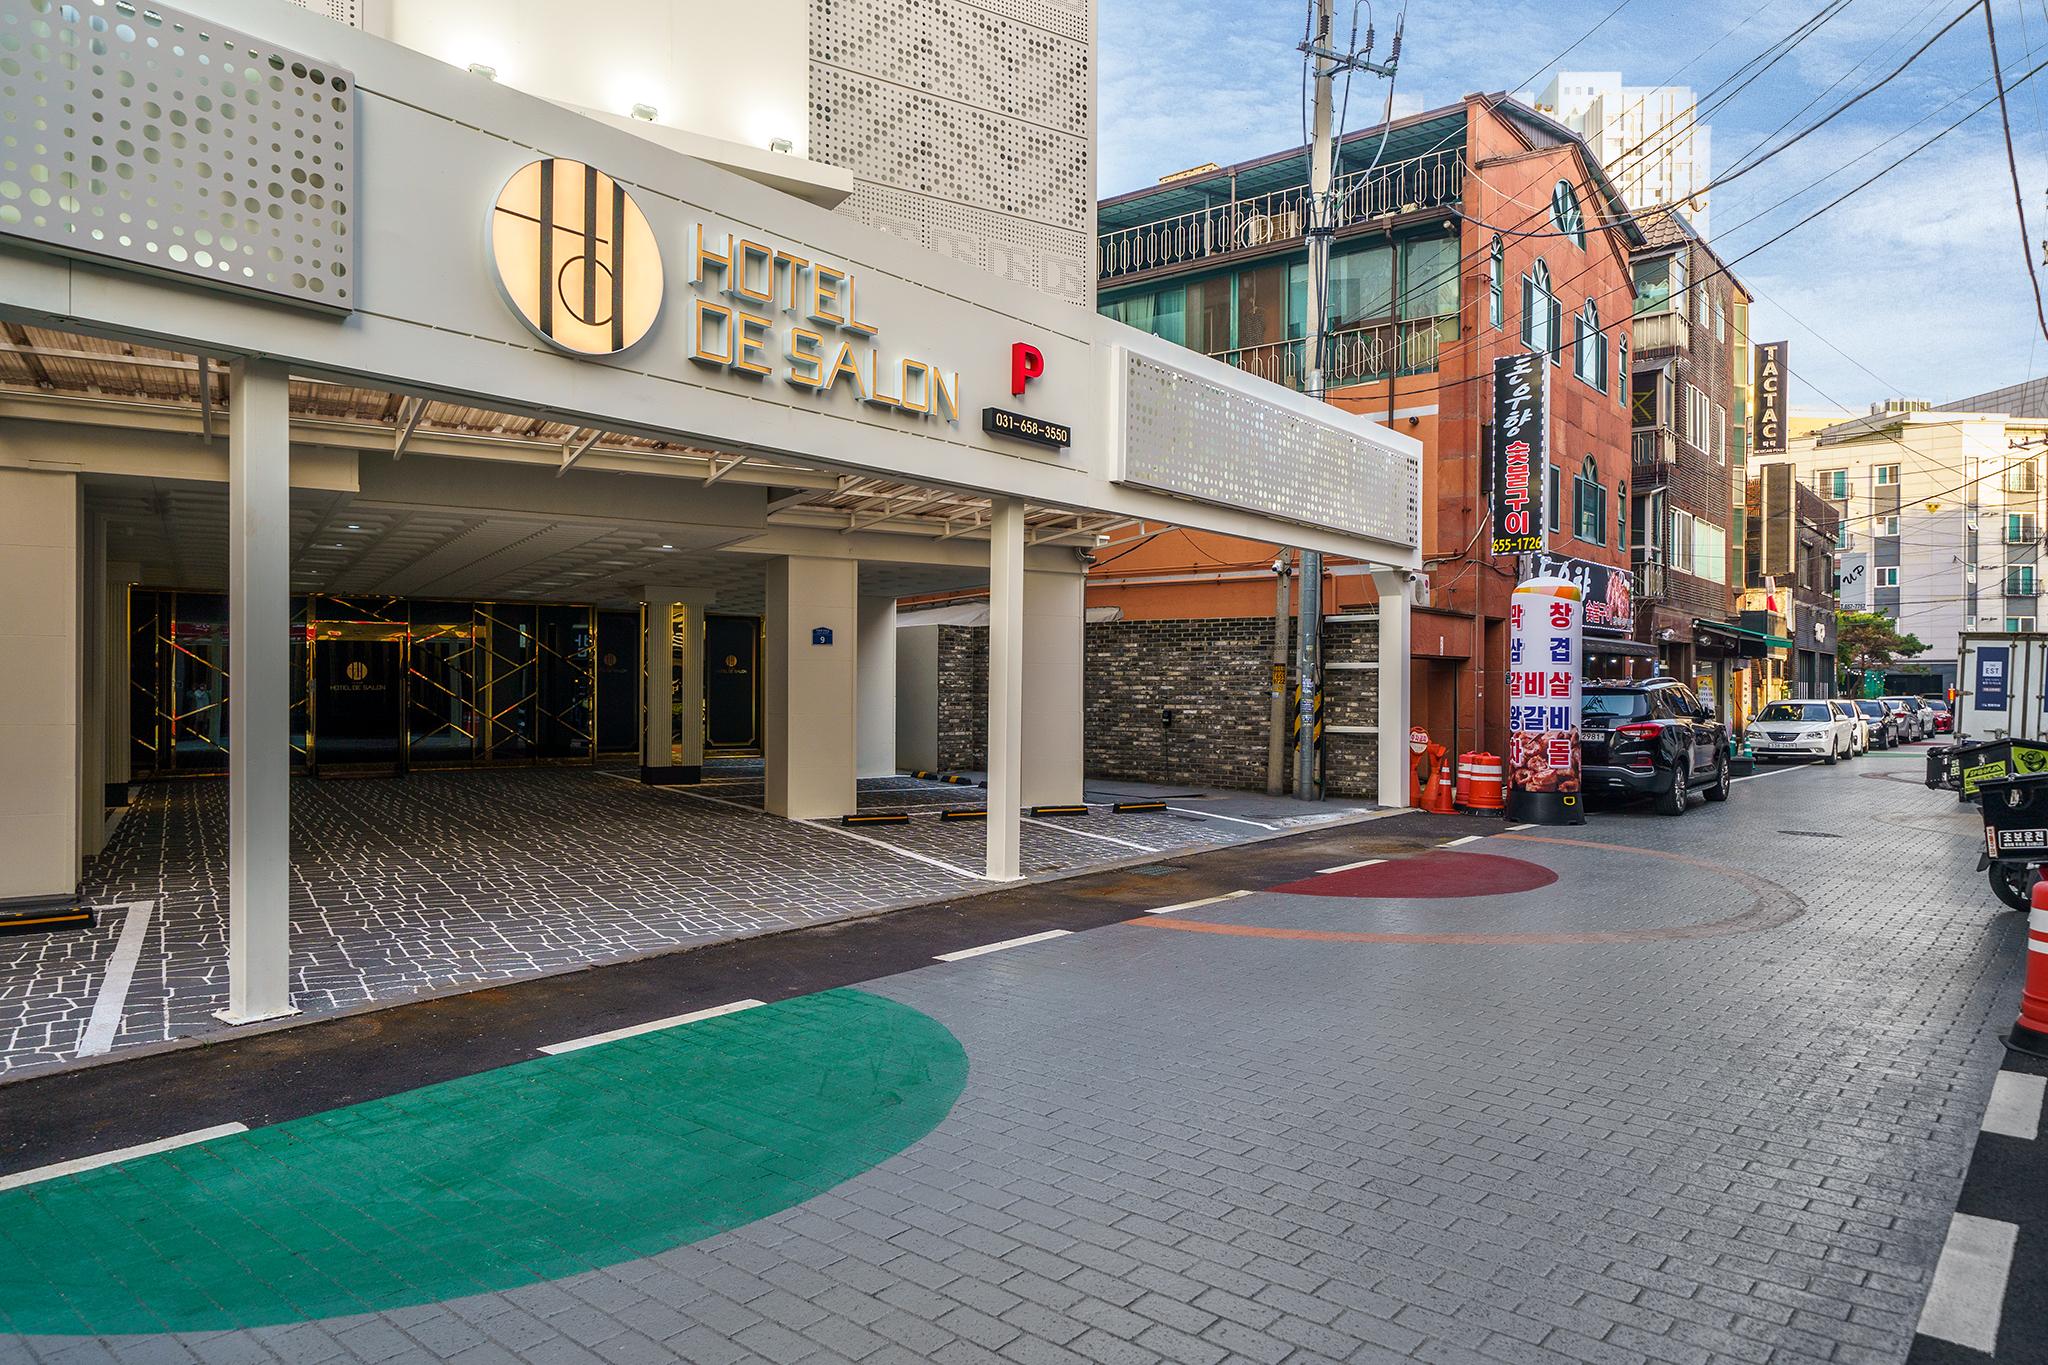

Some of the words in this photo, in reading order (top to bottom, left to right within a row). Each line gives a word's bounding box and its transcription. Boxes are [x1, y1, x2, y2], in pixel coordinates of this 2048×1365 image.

[688, 222, 881, 337] HOTEL
[688, 299, 774, 377] DE
[783, 326, 960, 422] SALON
[1011, 342, 1045, 397] P
[1503, 356, 1534, 438] 돈우향
[1761, 345, 1779, 439] TACTAC
[995, 412, 1068, 443] 031-658-3550
[1504, 439, 1531, 535] 숯불구이
[1493, 536, 1542, 553] 655-1726
[820, 636, 825, 644] 9
[1510, 671, 1572, 698] 갈비살
[1985, 667, 1999, 675] EST
[1510, 705, 1569, 731] 왕갈비
[2003, 831, 2044, 842] 초보운전
